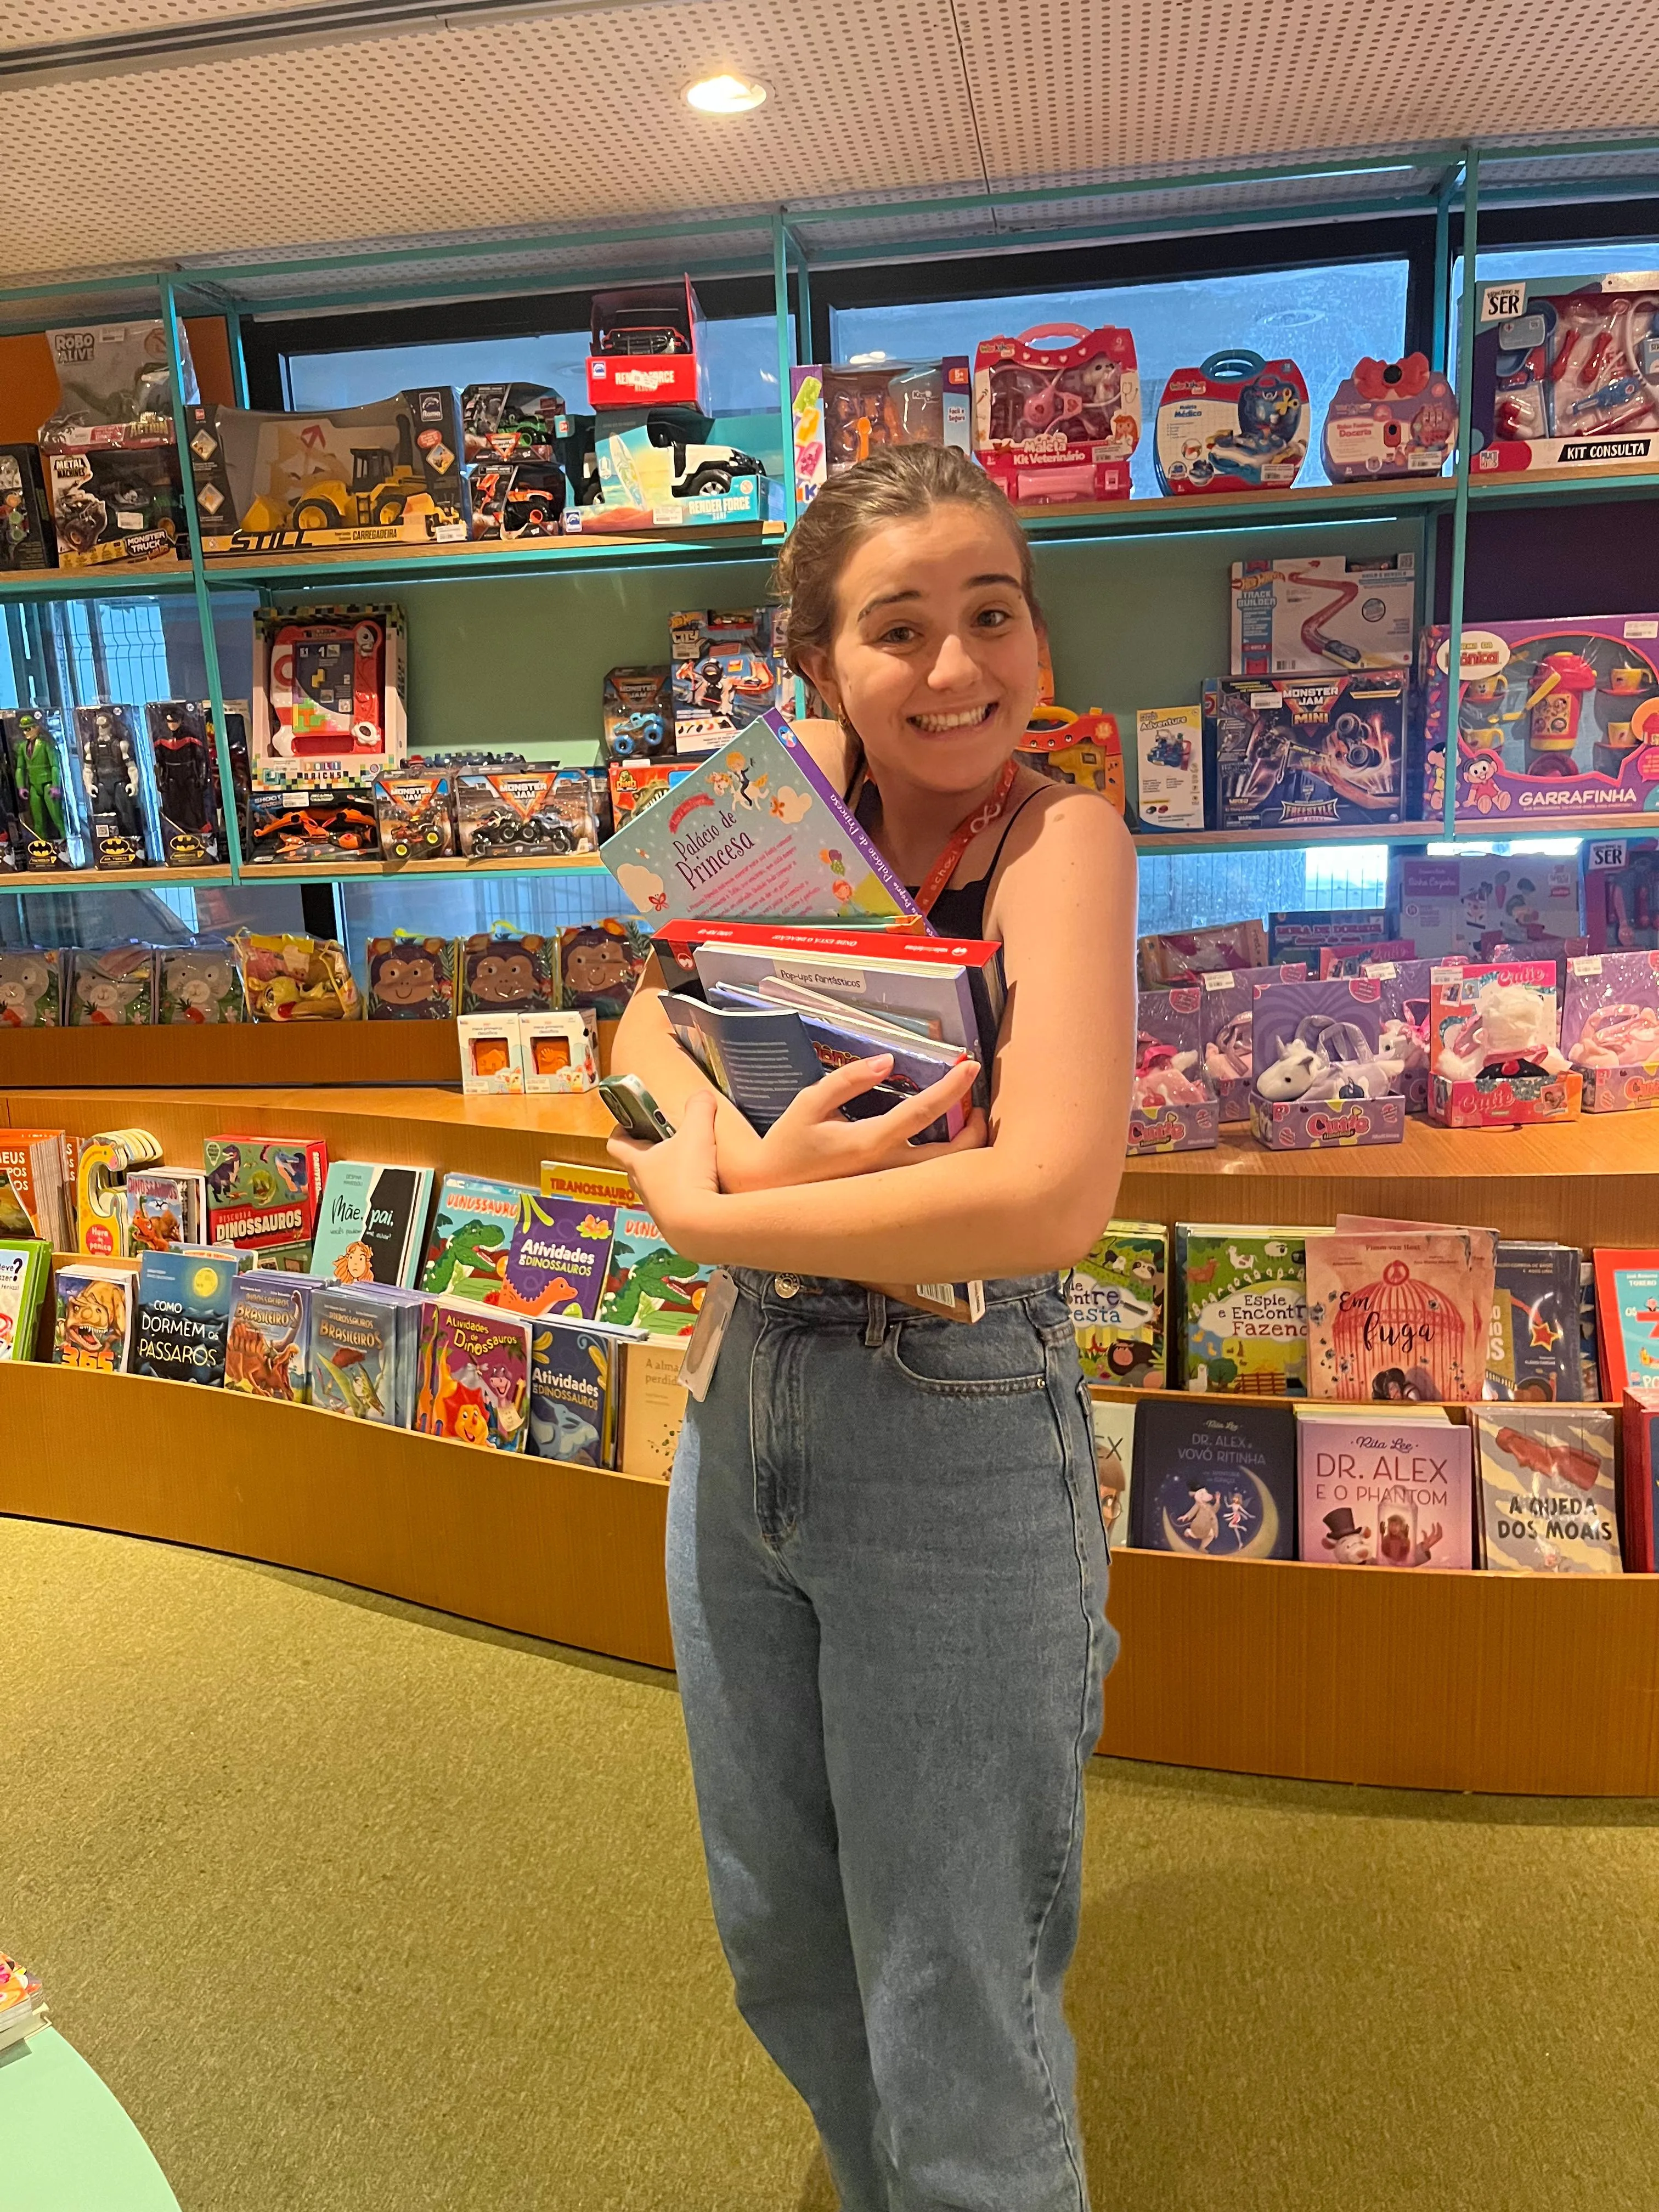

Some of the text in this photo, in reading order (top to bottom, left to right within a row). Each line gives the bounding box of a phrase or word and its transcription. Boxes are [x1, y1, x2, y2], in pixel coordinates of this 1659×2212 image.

[1488, 295, 1520, 315] SER
[58, 348, 94, 364] ALIVE
[1024, 441, 1066, 453] Maleta
[1567, 442, 1645, 460] KIT CONSULTA
[56, 459, 84, 469] METAL
[1014, 451, 1086, 465] Kit Veterinário
[689, 496, 751, 514] RENDER FORCE
[127, 531, 165, 546] MONSTER
[230, 531, 314, 551] STILL
[353, 528, 397, 541] CARREGADEIRA
[131, 540, 161, 553] TRUCK
[1238, 597, 1276, 607] BUILDER
[672, 630, 699, 643] CITY
[1445, 651, 1499, 668] ônica
[1283, 686, 1338, 698] MONSTER
[1299, 697, 1323, 706] JAM
[1140, 716, 1187, 731] Adventure
[1293, 713, 1328, 725] MINI
[391, 787, 432, 795] MONSTER
[500, 783, 548, 792] MONSTER
[1519, 787, 1637, 806] GARRAFINHA
[255, 795, 282, 804] SHOOT
[830, 794, 859, 836] Princesa
[1285, 805, 1333, 817] FREESTYLE
[673, 824, 720, 861] Palácio
[718, 810, 737, 828] de
[859, 835, 868, 846] de
[675, 832, 755, 891] Princesa
[868, 848, 893, 883] Palácio
[1595, 849, 1622, 865] SER
[815, 973, 861, 988] fantásticos
[1498, 967, 1546, 987] Cutie
[1460, 1090, 1515, 1114] Cutie
[1128, 1112, 1186, 1144] Cutie
[1307, 1105, 1370, 1136] Cutie
[550, 1177, 635, 1202] TIRANOSSAURO
[92, 1227, 108, 1237] Hora
[217, 1209, 302, 1242] DINOSSAUROS
[521, 1239, 595, 1265] Atividades
[526, 1255, 592, 1277] DINOSSAUROS
[154, 1300, 182, 1313] COMO
[1339, 1291, 1373, 1312] Em
[236, 1302, 296, 1328] BRASILEIROS
[1218, 1310, 1226, 1318] e
[142, 1315, 205, 1339] DORMEM
[446, 1314, 489, 1334] Atividades
[1363, 1311, 1435, 1353] fuga
[319, 1319, 384, 1350] BRASILEIROS
[453, 1329, 517, 1356] Dinossauros
[61, 1345, 114, 1372] 365
[139, 1334, 218, 1366] PÁSSAROS
[645, 1358, 679, 1372] A alma
[533, 1367, 599, 1397] Atividades
[538, 1385, 599, 1412] DINOSSAUROS
[1192, 1433, 1246, 1449] DR. ALEX
[1356, 1436, 1414, 1453] Rita Lee
[1178, 1447, 1266, 1466] VOVÓ RITINHA
[1317, 1453, 1448, 1485] DR. ALEX
[1317, 1484, 1447, 1506] E O PHANTOM
[1509, 1497, 1522, 1515] A
[1498, 1520, 1612, 1542] DOS MOAIS
